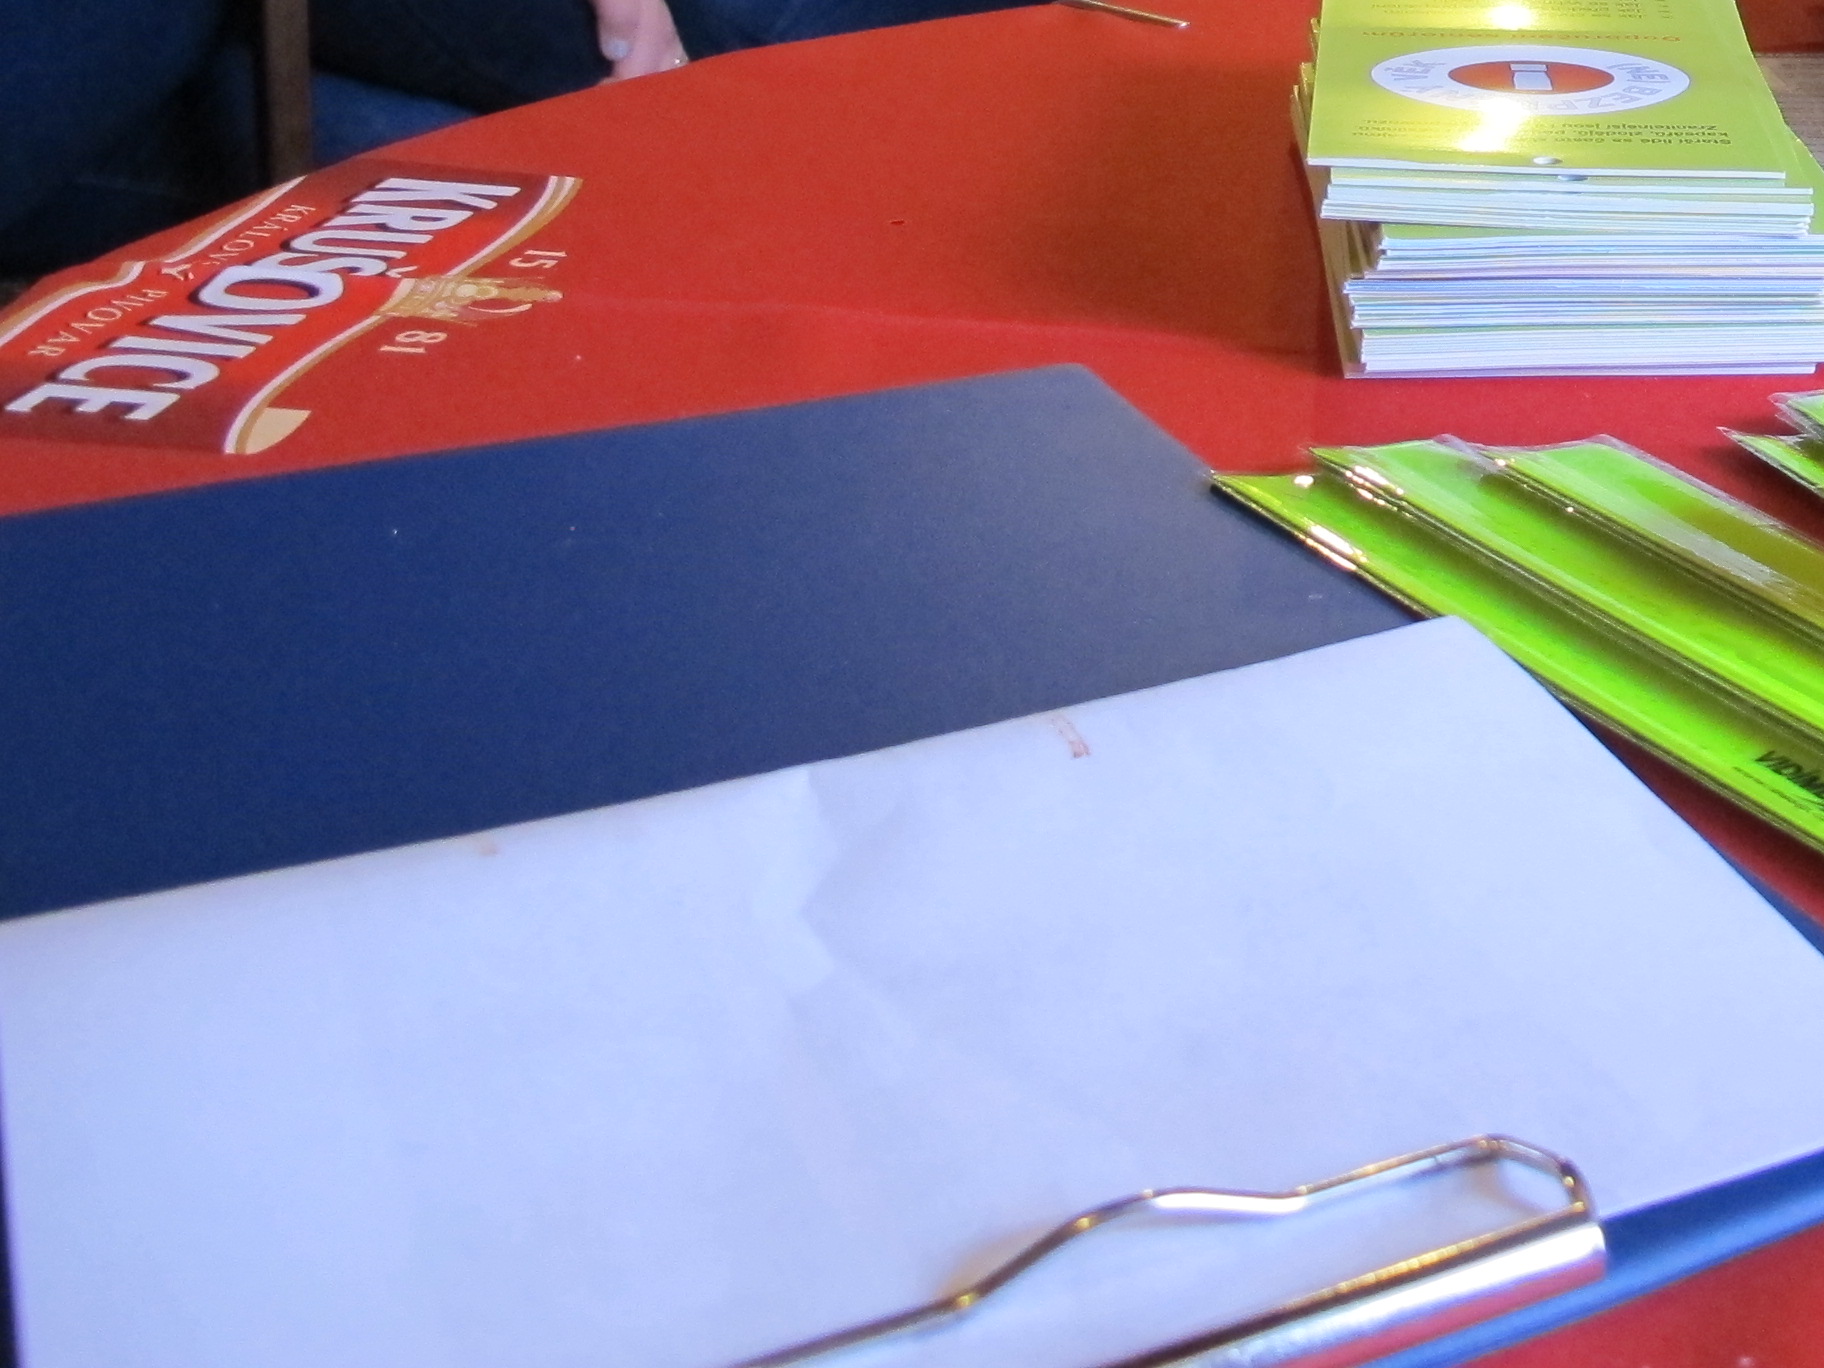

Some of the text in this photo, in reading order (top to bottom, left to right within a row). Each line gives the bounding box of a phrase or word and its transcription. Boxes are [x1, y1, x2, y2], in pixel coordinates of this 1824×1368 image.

[4, 177, 523, 421] KRUŠOVICE
[28, 288, 169, 358] PIVOVAR
[379, 249, 568, 354] 15 81
